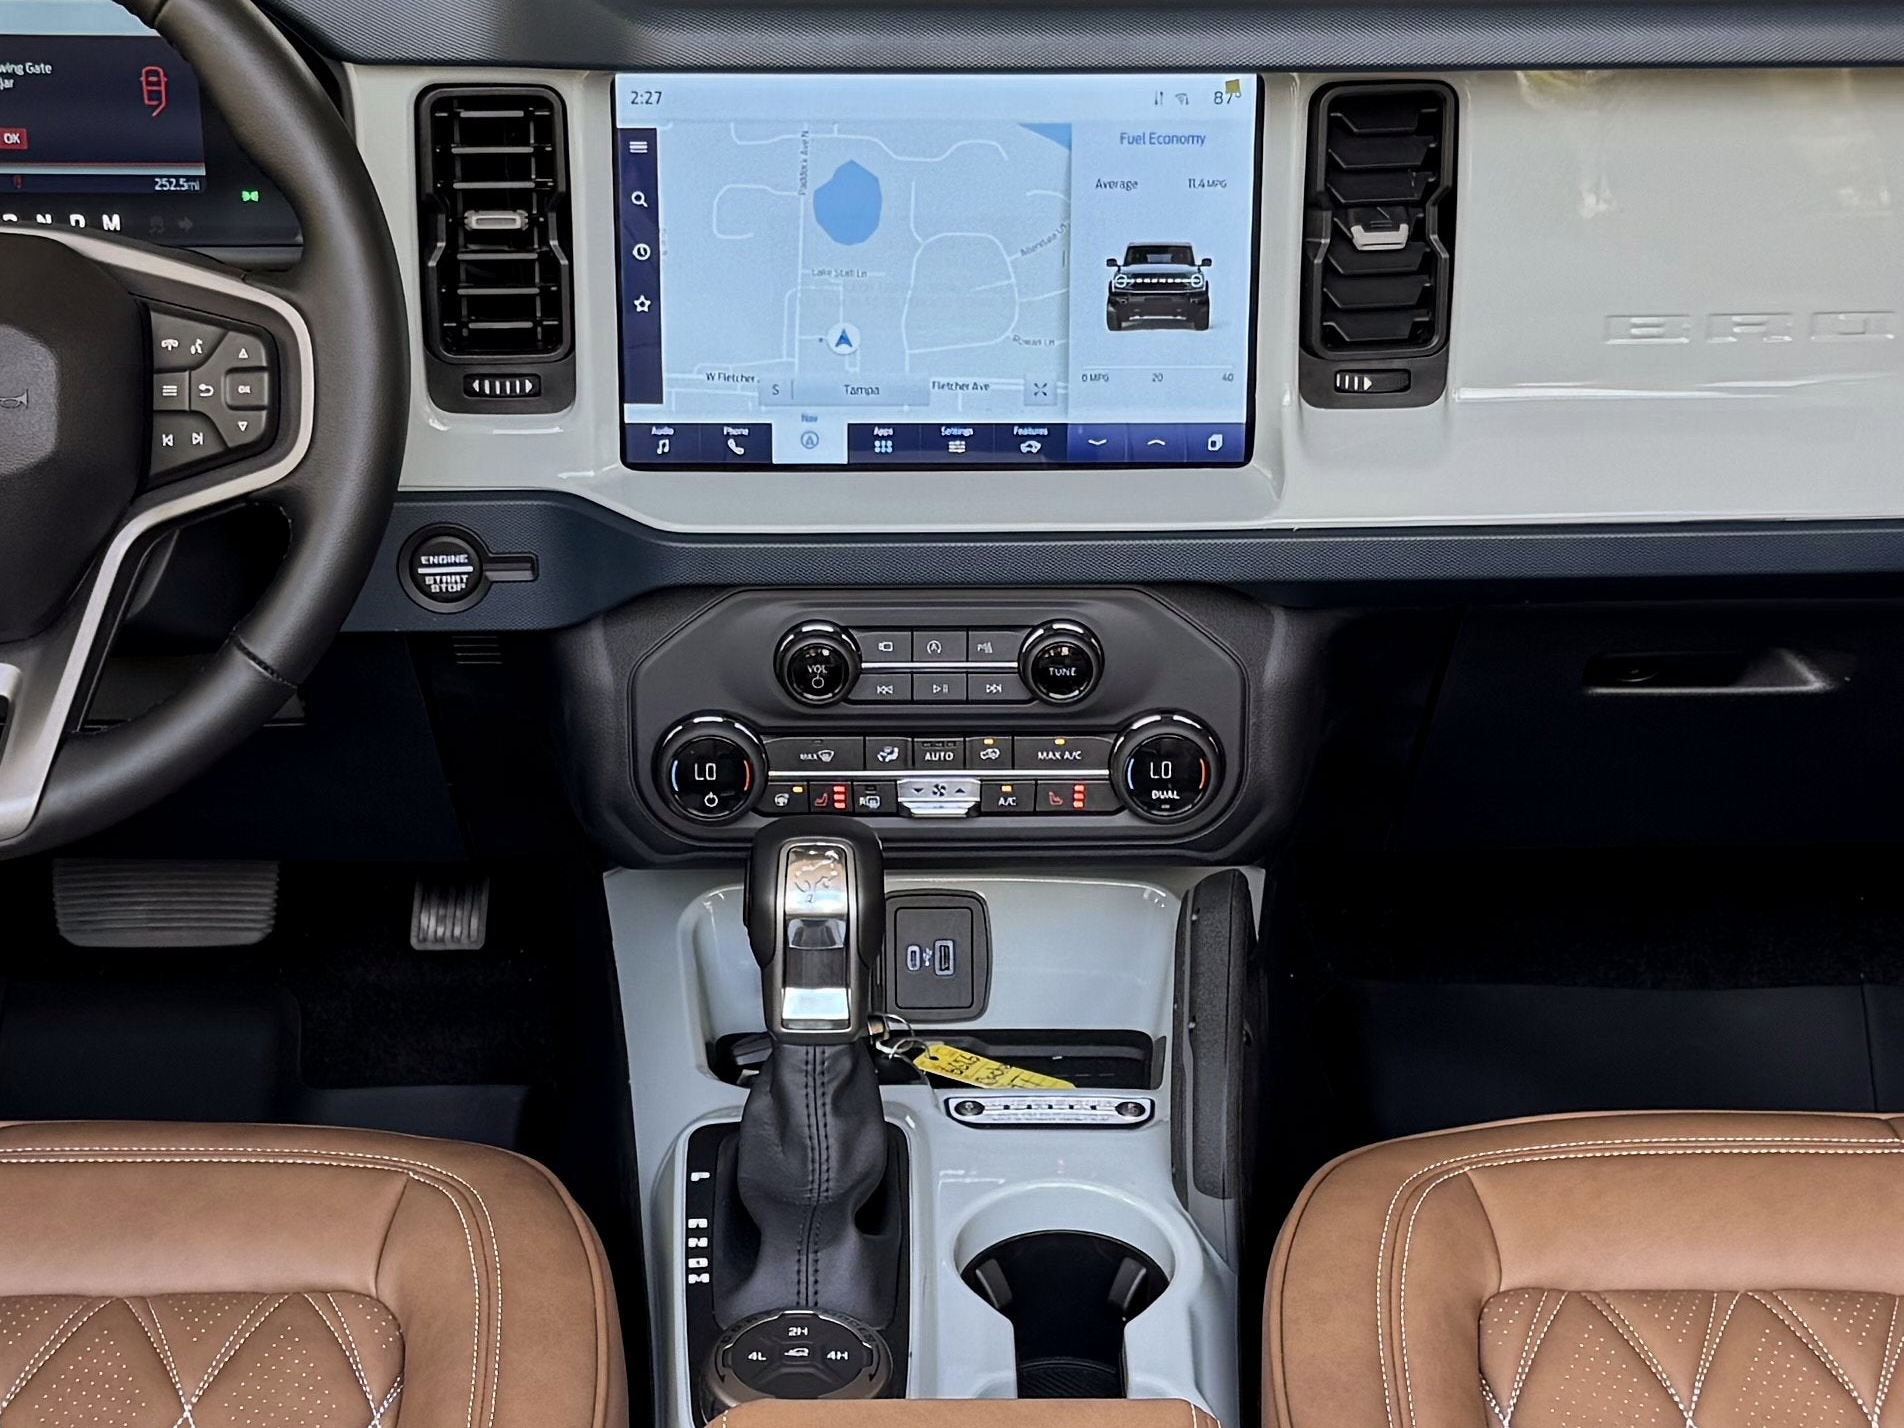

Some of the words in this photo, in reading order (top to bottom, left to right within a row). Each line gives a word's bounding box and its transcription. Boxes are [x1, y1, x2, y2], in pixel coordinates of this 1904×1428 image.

[25, 62, 52, 74] Gate
[630, 91, 662, 105] 2:27
[3, 133, 21, 144] OK
[1120, 132, 1146, 145] Fuel
[1149, 132, 1206, 147] Economy
[1095, 178, 1138, 190] Average
[102, 214, 121, 232] M
[1152, 373, 1163, 382] 20
[1222, 373, 1234, 382] 40
[772, 384, 780, 395] S
[844, 385, 880, 396] Tampa
[932, 381, 969, 392] Fletcher
[971, 381, 990, 391] Ave
[651, 426, 674, 435] Audio
[723, 426, 749, 436] Phone
[873, 426, 893, 436] Apps
[941, 426, 974, 436] Settings
[1013, 426, 1048, 436] Features
[421, 554, 468, 564] ENGINE
[807, 664, 828, 675] VOL
[1049, 667, 1077, 677] TUNE
[925, 751, 954, 761] AUTO
[1037, 751, 1061, 761] MAX
[1063, 750, 1082, 761] A/C
[694, 763, 717, 781] LO
[1149, 761, 1172, 779] LO
[1151, 789, 1180, 800] DUAL
[998, 796, 1017, 807] A/C
[788, 1327, 808, 1336] 2H
[748, 1351, 767, 1361] 4L
[826, 1351, 849, 1361] 4H
